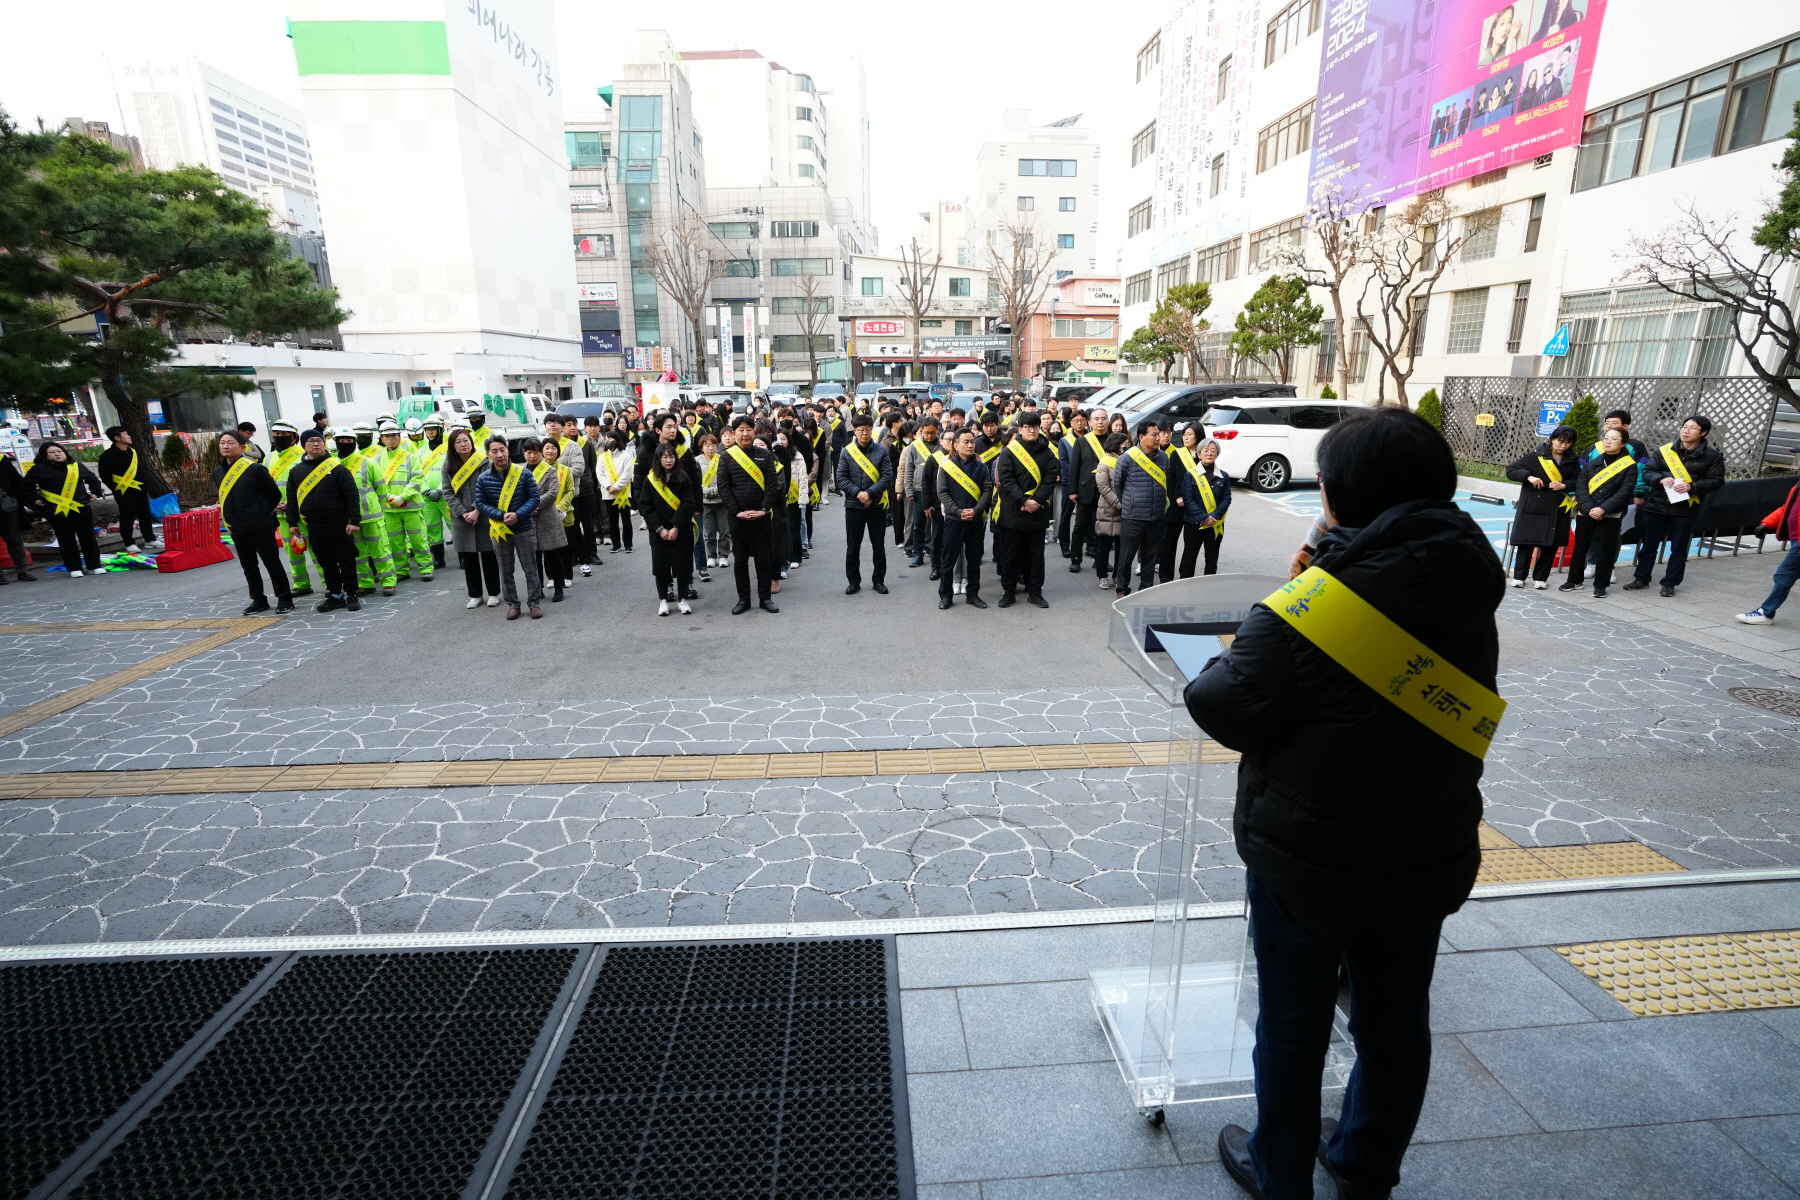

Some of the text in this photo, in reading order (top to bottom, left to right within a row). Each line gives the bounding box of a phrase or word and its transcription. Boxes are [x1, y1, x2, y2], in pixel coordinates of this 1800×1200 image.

[1326, 11, 1367, 58] 2024
[530, 47, 554, 97] 강북
[1209, 21, 1220, 112] 최우수상
[945, 204, 962, 213] BAR
[1546, 411, 1556, 423] P
[1421, 684, 1473, 722] 쓰레기
